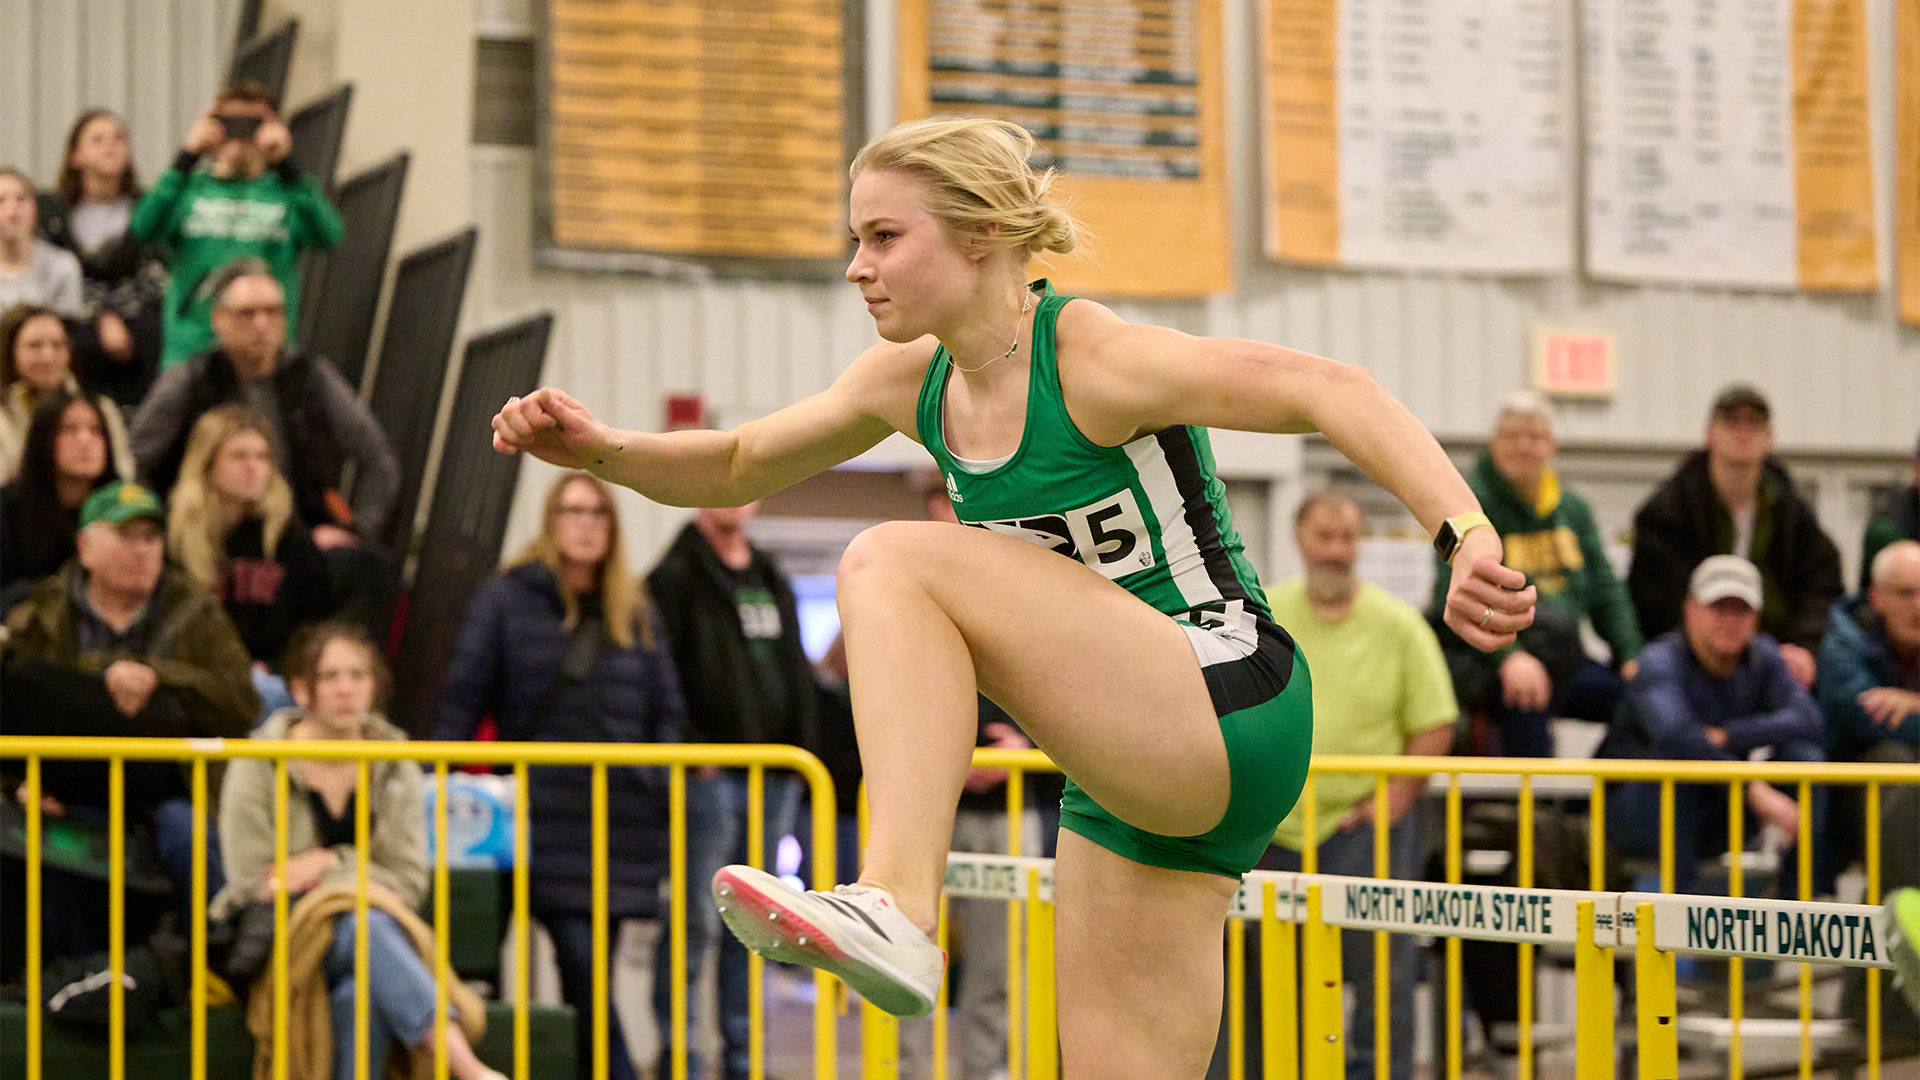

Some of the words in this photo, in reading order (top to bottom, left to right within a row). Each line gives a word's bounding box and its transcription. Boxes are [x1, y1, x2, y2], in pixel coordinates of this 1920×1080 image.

[1086, 503, 1136, 564] 5
[1346, 885, 1406, 922] NORTH
[1413, 888, 1486, 929] DAKOTA
[1492, 891, 1552, 934] STATE
[1687, 906, 1767, 953] NORTH
[1777, 911, 1877, 961] DAKOTA
